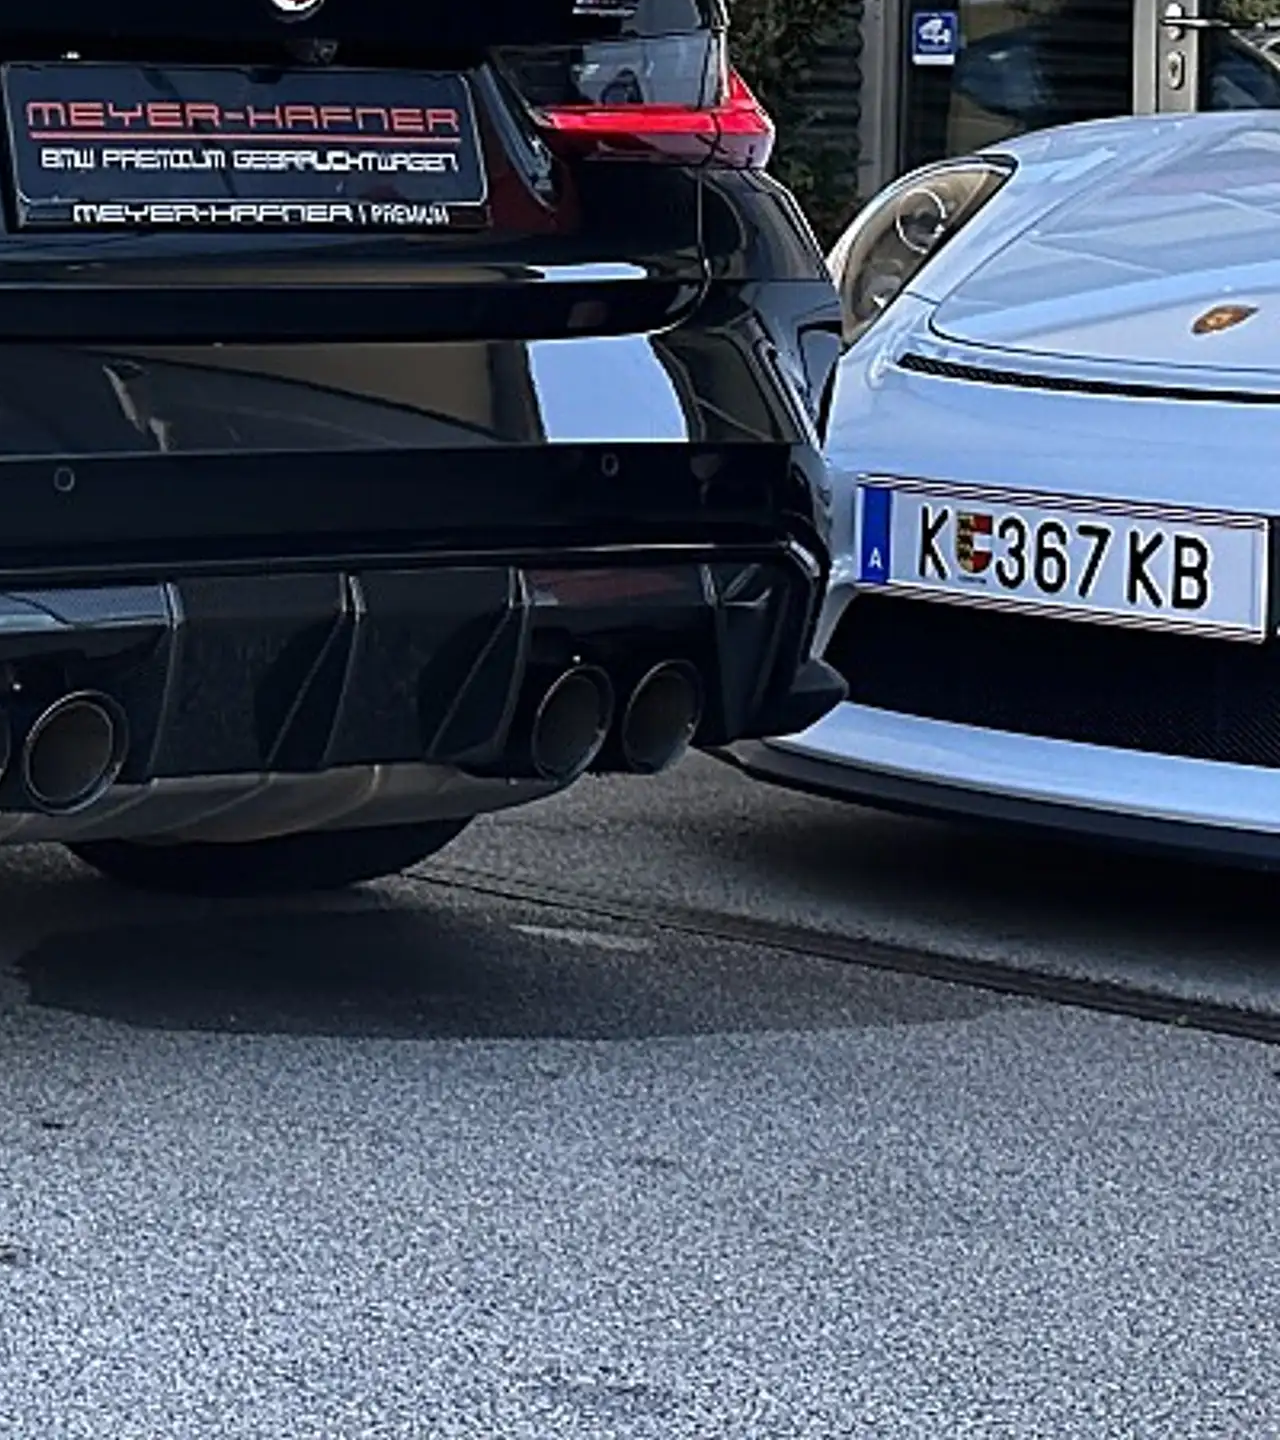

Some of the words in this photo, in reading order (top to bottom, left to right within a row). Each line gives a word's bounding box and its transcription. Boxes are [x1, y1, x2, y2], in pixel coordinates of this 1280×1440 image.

[26, 101, 460, 133] MEYER-HAFNER
[40, 147, 95, 170] BMW
[102, 147, 226, 171] PREMIUM
[232, 149, 459, 173] GEBRAUCHTWAGEN
[72, 203, 354, 224] MEYER-HAFNER
[918, 505, 949, 581] K
[994, 515, 1111, 599] 367
[1126, 529, 1210, 610] KB
